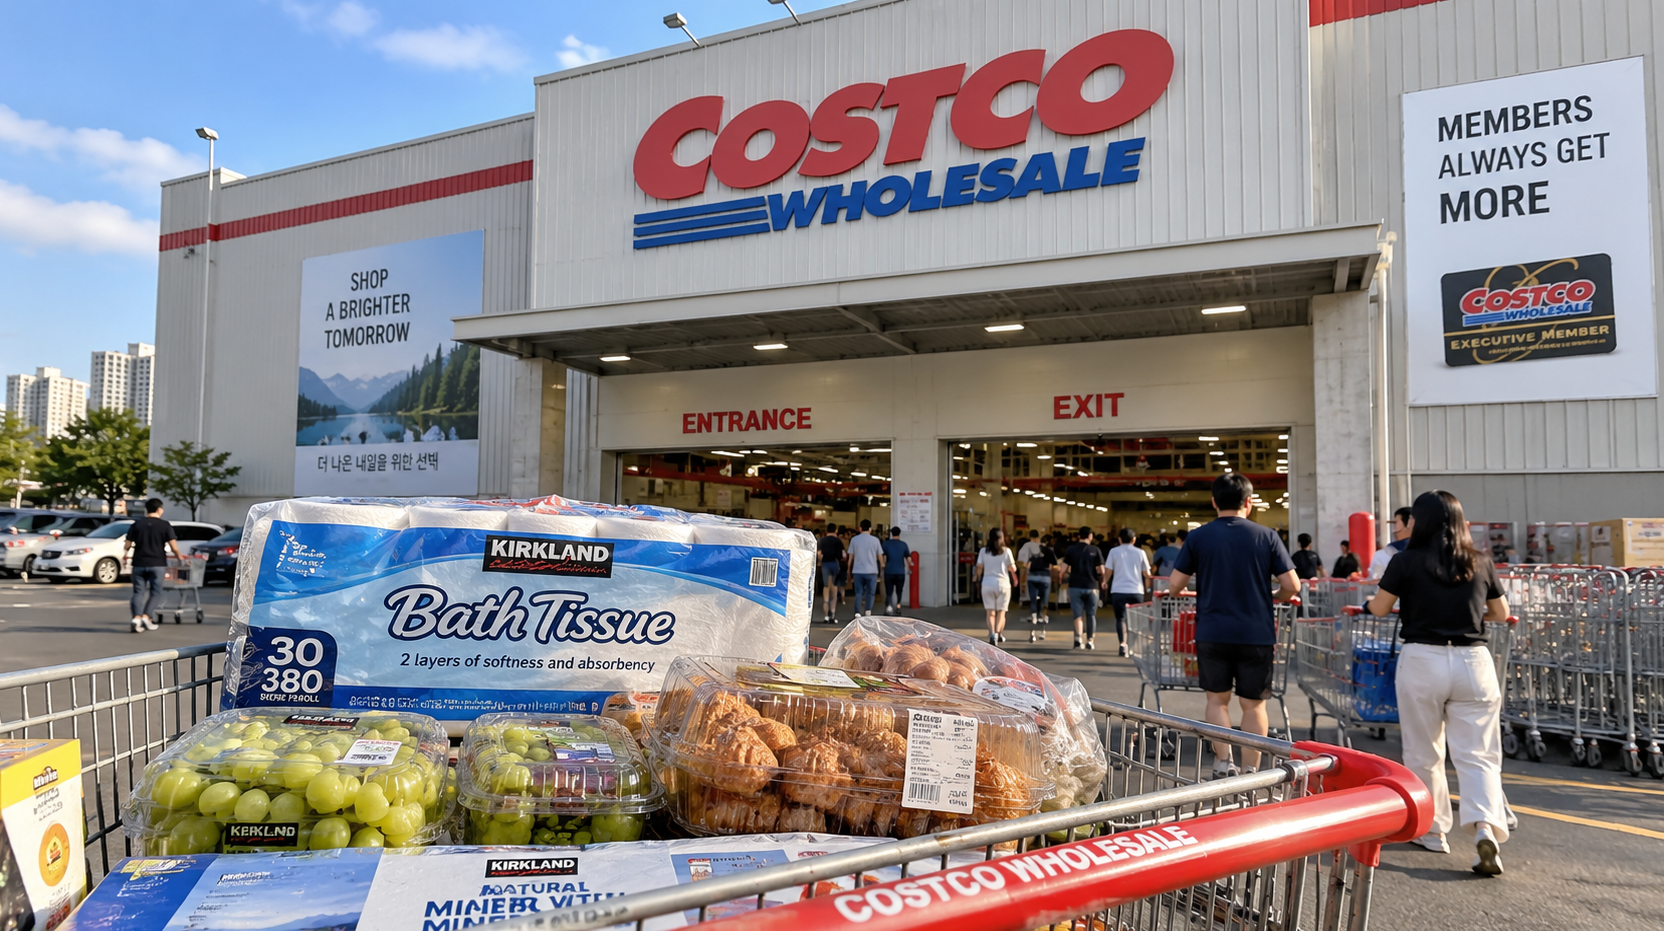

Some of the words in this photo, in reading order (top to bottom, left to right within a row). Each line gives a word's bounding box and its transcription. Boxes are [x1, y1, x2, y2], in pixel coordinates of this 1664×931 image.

[633, 28, 1175, 200] COSTCO
[1438, 95, 1593, 142] MEMBERS
[1438, 141, 1547, 179] ALWAYS
[1557, 132, 1610, 164] GET
[767, 137, 1145, 232] WHOLESALE
[1440, 180, 1550, 224] MORE
[351, 268, 388, 291] SHOP
[325, 302, 335, 321] A
[340, 293, 410, 320] BRIGHTER
[1460, 280, 1595, 314] COSTCO
[1504, 302, 1592, 320] WHOLESALE
[324, 322, 410, 349] TOMORROW
[1451, 332, 1535, 350] EXECUTIVE
[1542, 325, 1609, 340] MEMBER
[1053, 393, 1124, 420] EXIT
[682, 407, 812, 434] ENTRANCE
[318, 454, 327, 473] 더
[391, 452, 413, 471] 위한
[490, 539, 610, 563] KIRKLAND
[384, 584, 529, 641] Bath
[531, 590, 676, 645] Tissue
[267, 636, 324, 667] 30
[400, 653, 411, 666] 2
[414, 653, 460, 670] layers
[465, 654, 481, 668] of
[483, 655, 544, 669] softness
[548, 657, 574, 669] and
[578, 657, 656, 673] absorbency
[261, 667, 323, 694] 380
[491, 859, 576, 871] KIRKLAND
[834, 866, 1005, 922] COSTCO
[1000, 826, 1198, 883] WHOLESALE
